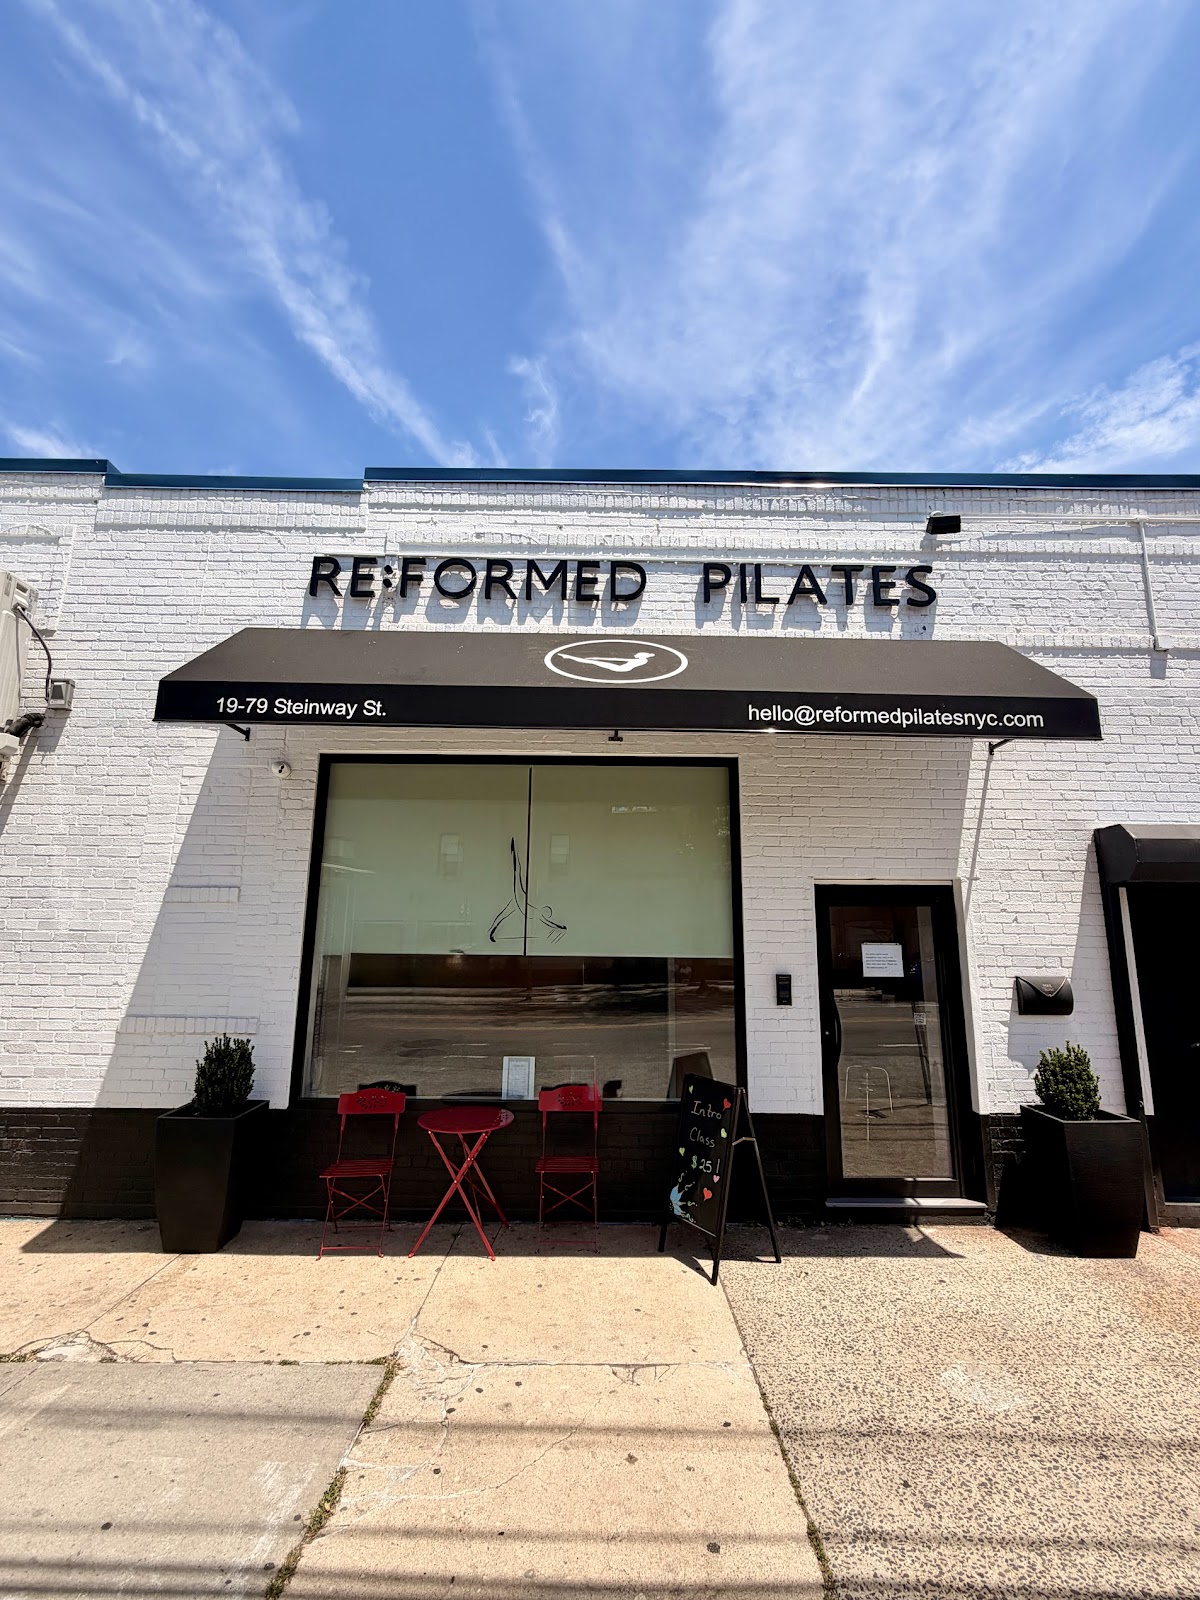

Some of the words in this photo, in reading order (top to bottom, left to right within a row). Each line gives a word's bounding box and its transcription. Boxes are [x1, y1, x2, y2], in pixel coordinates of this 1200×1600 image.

[309, 556, 647, 602] RE:FORMED
[702, 562, 938, 608] PILATES
[216, 697, 268, 714] 19-79
[273, 698, 357, 719] Steinway
[362, 700, 387, 716] St.
[748, 704, 1045, 730] hello@reformedpilatesnyc.com
[690, 1100, 722, 1120] Intro
[689, 1126, 716, 1148] Class
